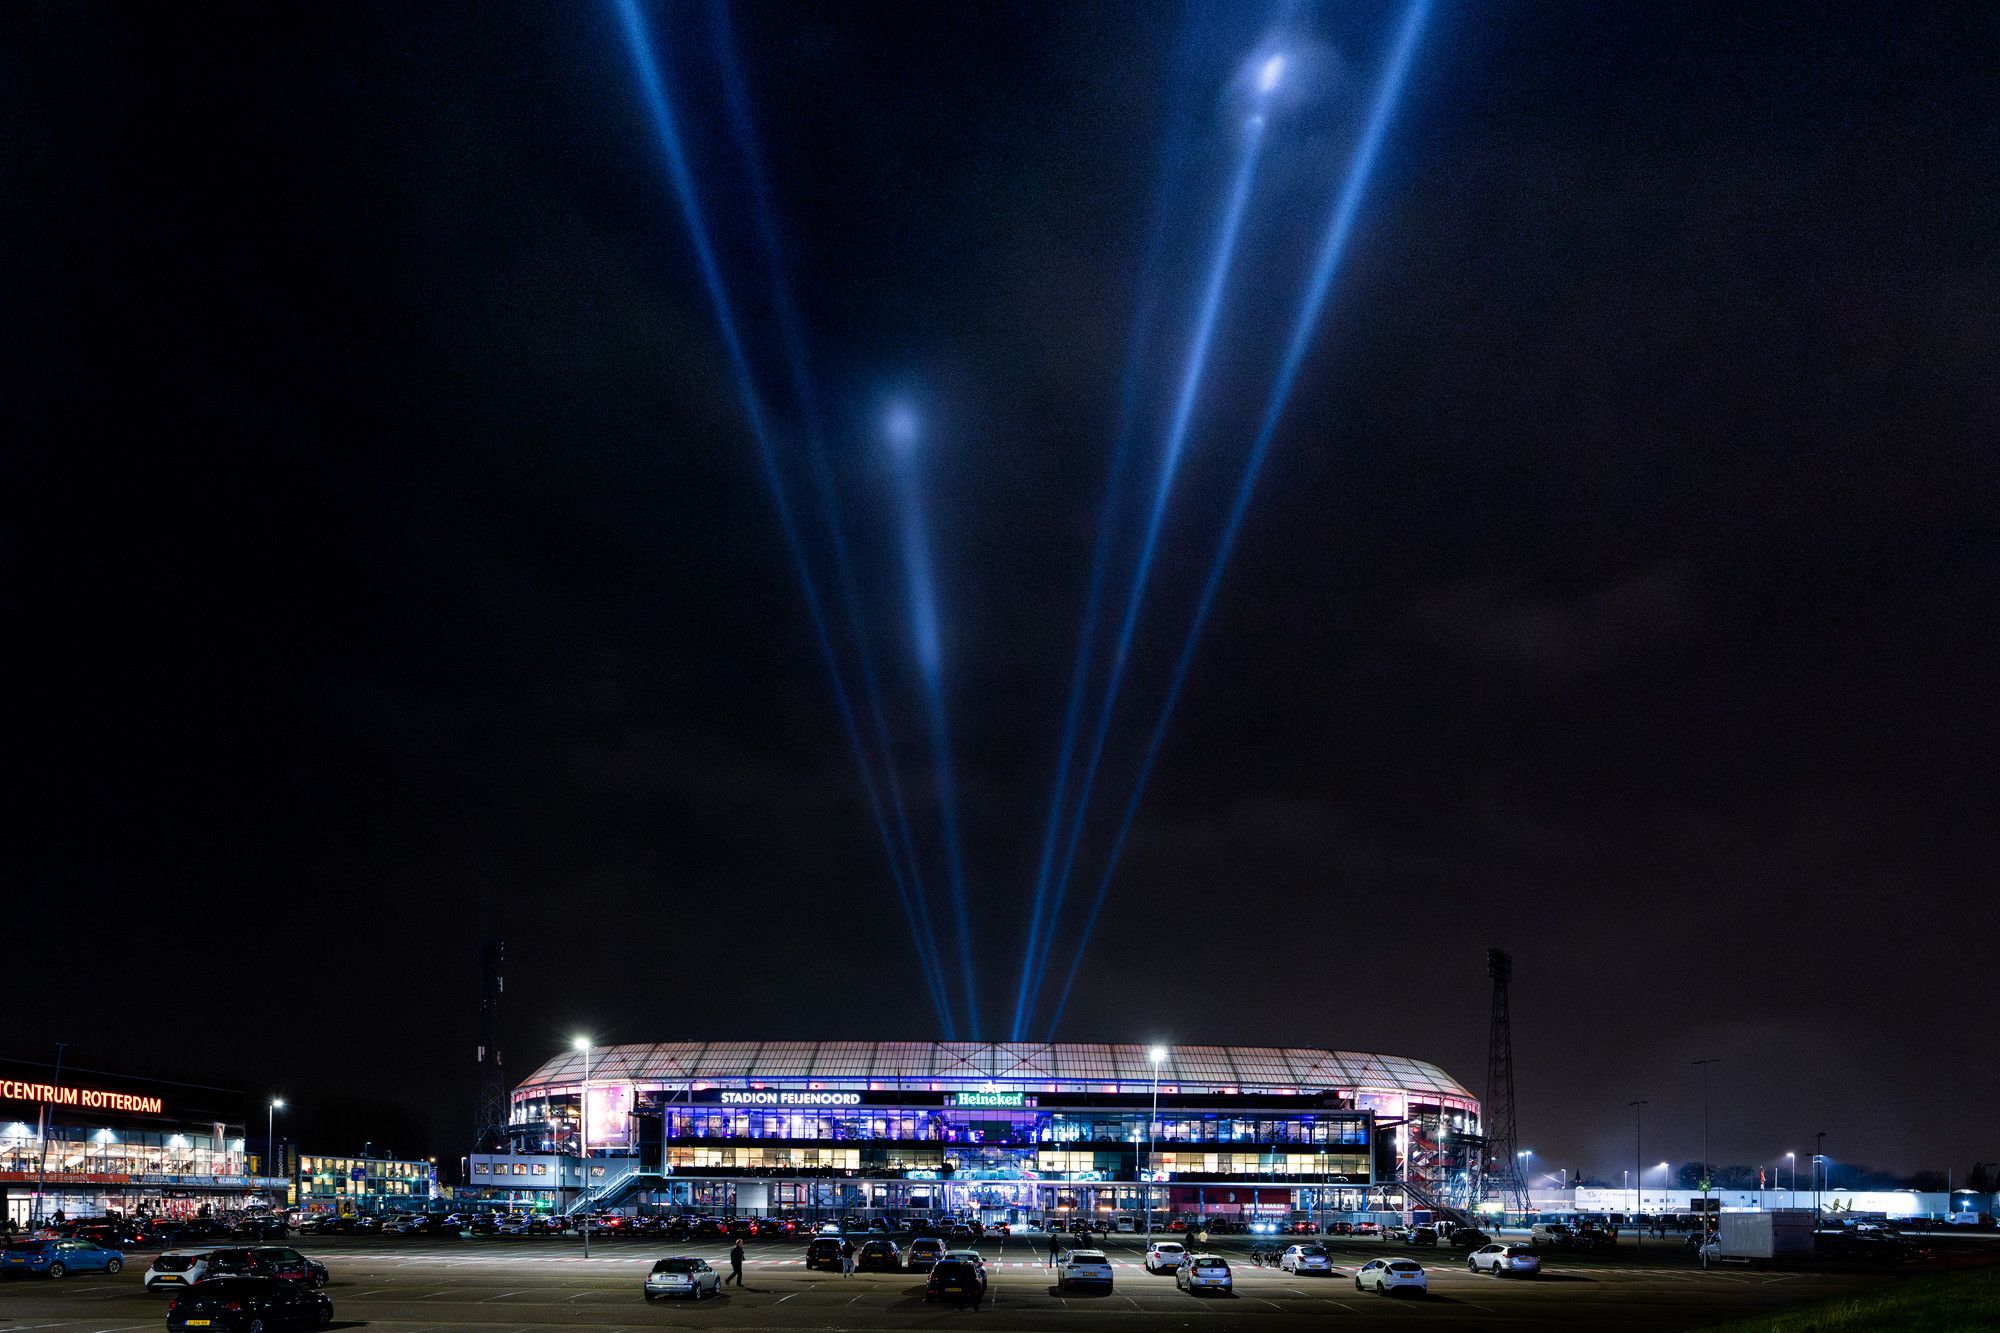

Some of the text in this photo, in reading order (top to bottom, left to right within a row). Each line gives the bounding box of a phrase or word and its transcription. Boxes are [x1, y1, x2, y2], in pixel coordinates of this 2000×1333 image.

[82, 1090, 161, 1113] ROTTERDAM
[721, 1092, 860, 1105] STADION FEIJENOORD
[958, 1093, 1023, 1105] Heineken
[48, 1173, 58, 1181] of
[59, 1173, 90, 1181] TeamNL
